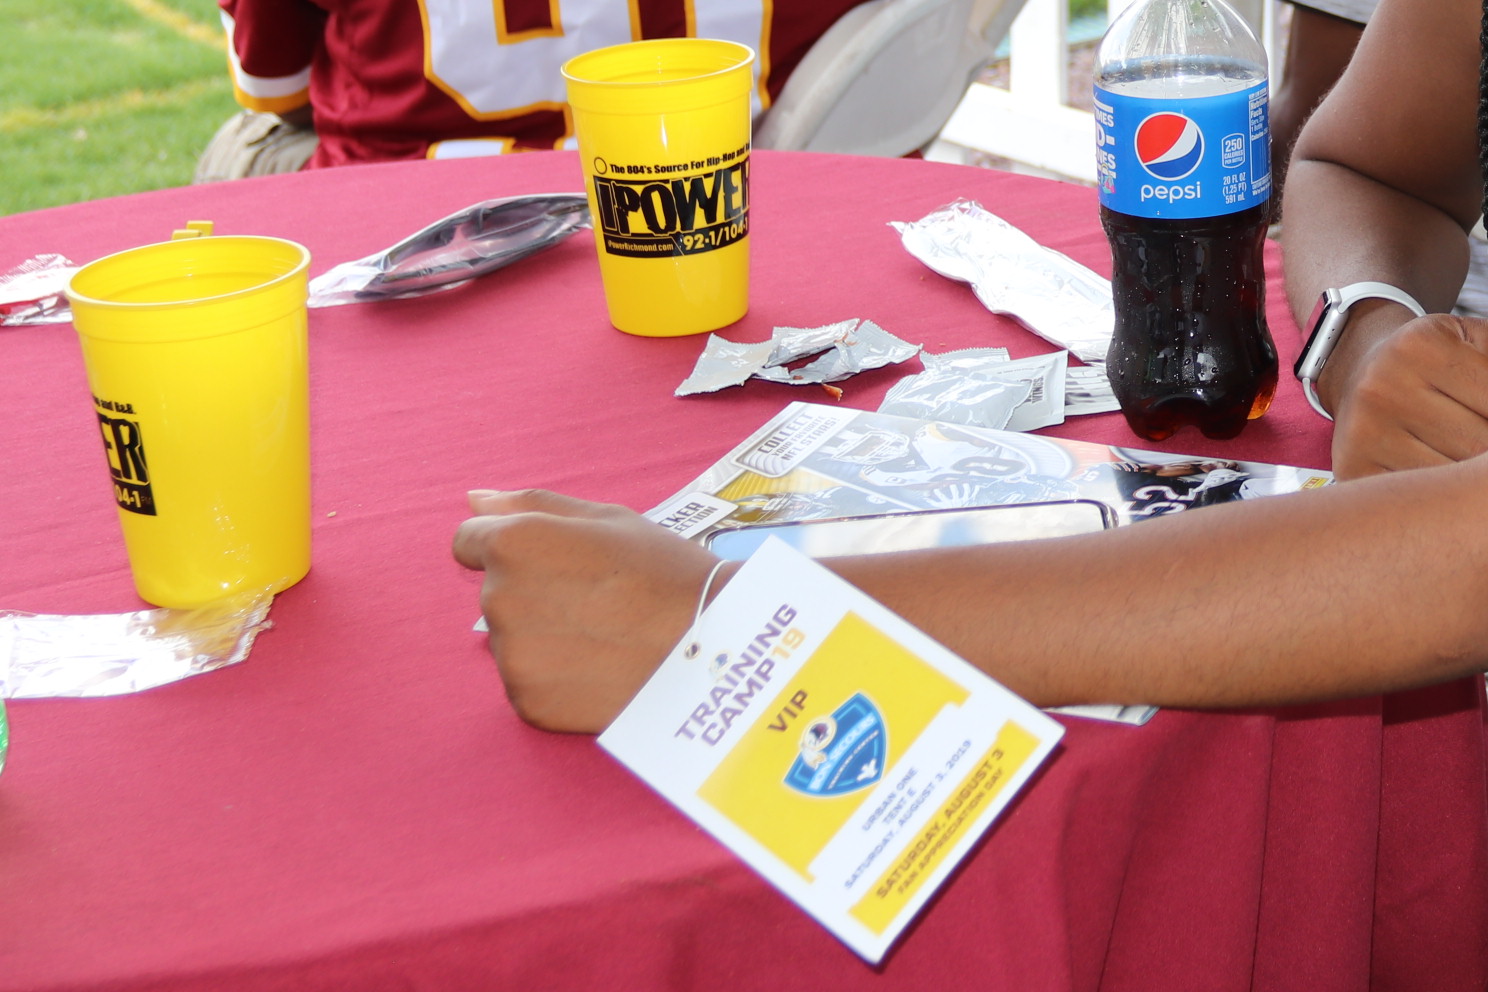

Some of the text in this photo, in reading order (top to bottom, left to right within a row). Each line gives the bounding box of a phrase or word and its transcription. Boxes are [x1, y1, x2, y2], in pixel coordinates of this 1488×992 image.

[609, 163, 625, 173] The
[627, 165, 652, 174] 804's
[654, 163, 688, 173] Source
[691, 160, 705, 169] For
[706, 152, 736, 166] Hip-Hop
[1225, 138, 1242, 152] 250
[1140, 181, 1201, 204] pepsi
[1223, 175, 1231, 185] 20
[1232, 174, 1238, 183] FL
[1225, 194, 1236, 205] 591
[757, 412, 813, 455] COLLECT
[674, 603, 797, 744] TRAINING
[768, 689, 811, 736] VIP
[862, 767, 917, 831] URBAN ONE
[897, 783, 935, 826] AUGUST
[945, 739, 971, 768] 2019
[943, 760, 993, 818] AUGUST
[992, 748, 1003, 760] 3
[883, 788, 915, 825] TENT E
[918, 791, 984, 869] APPRECIATION
